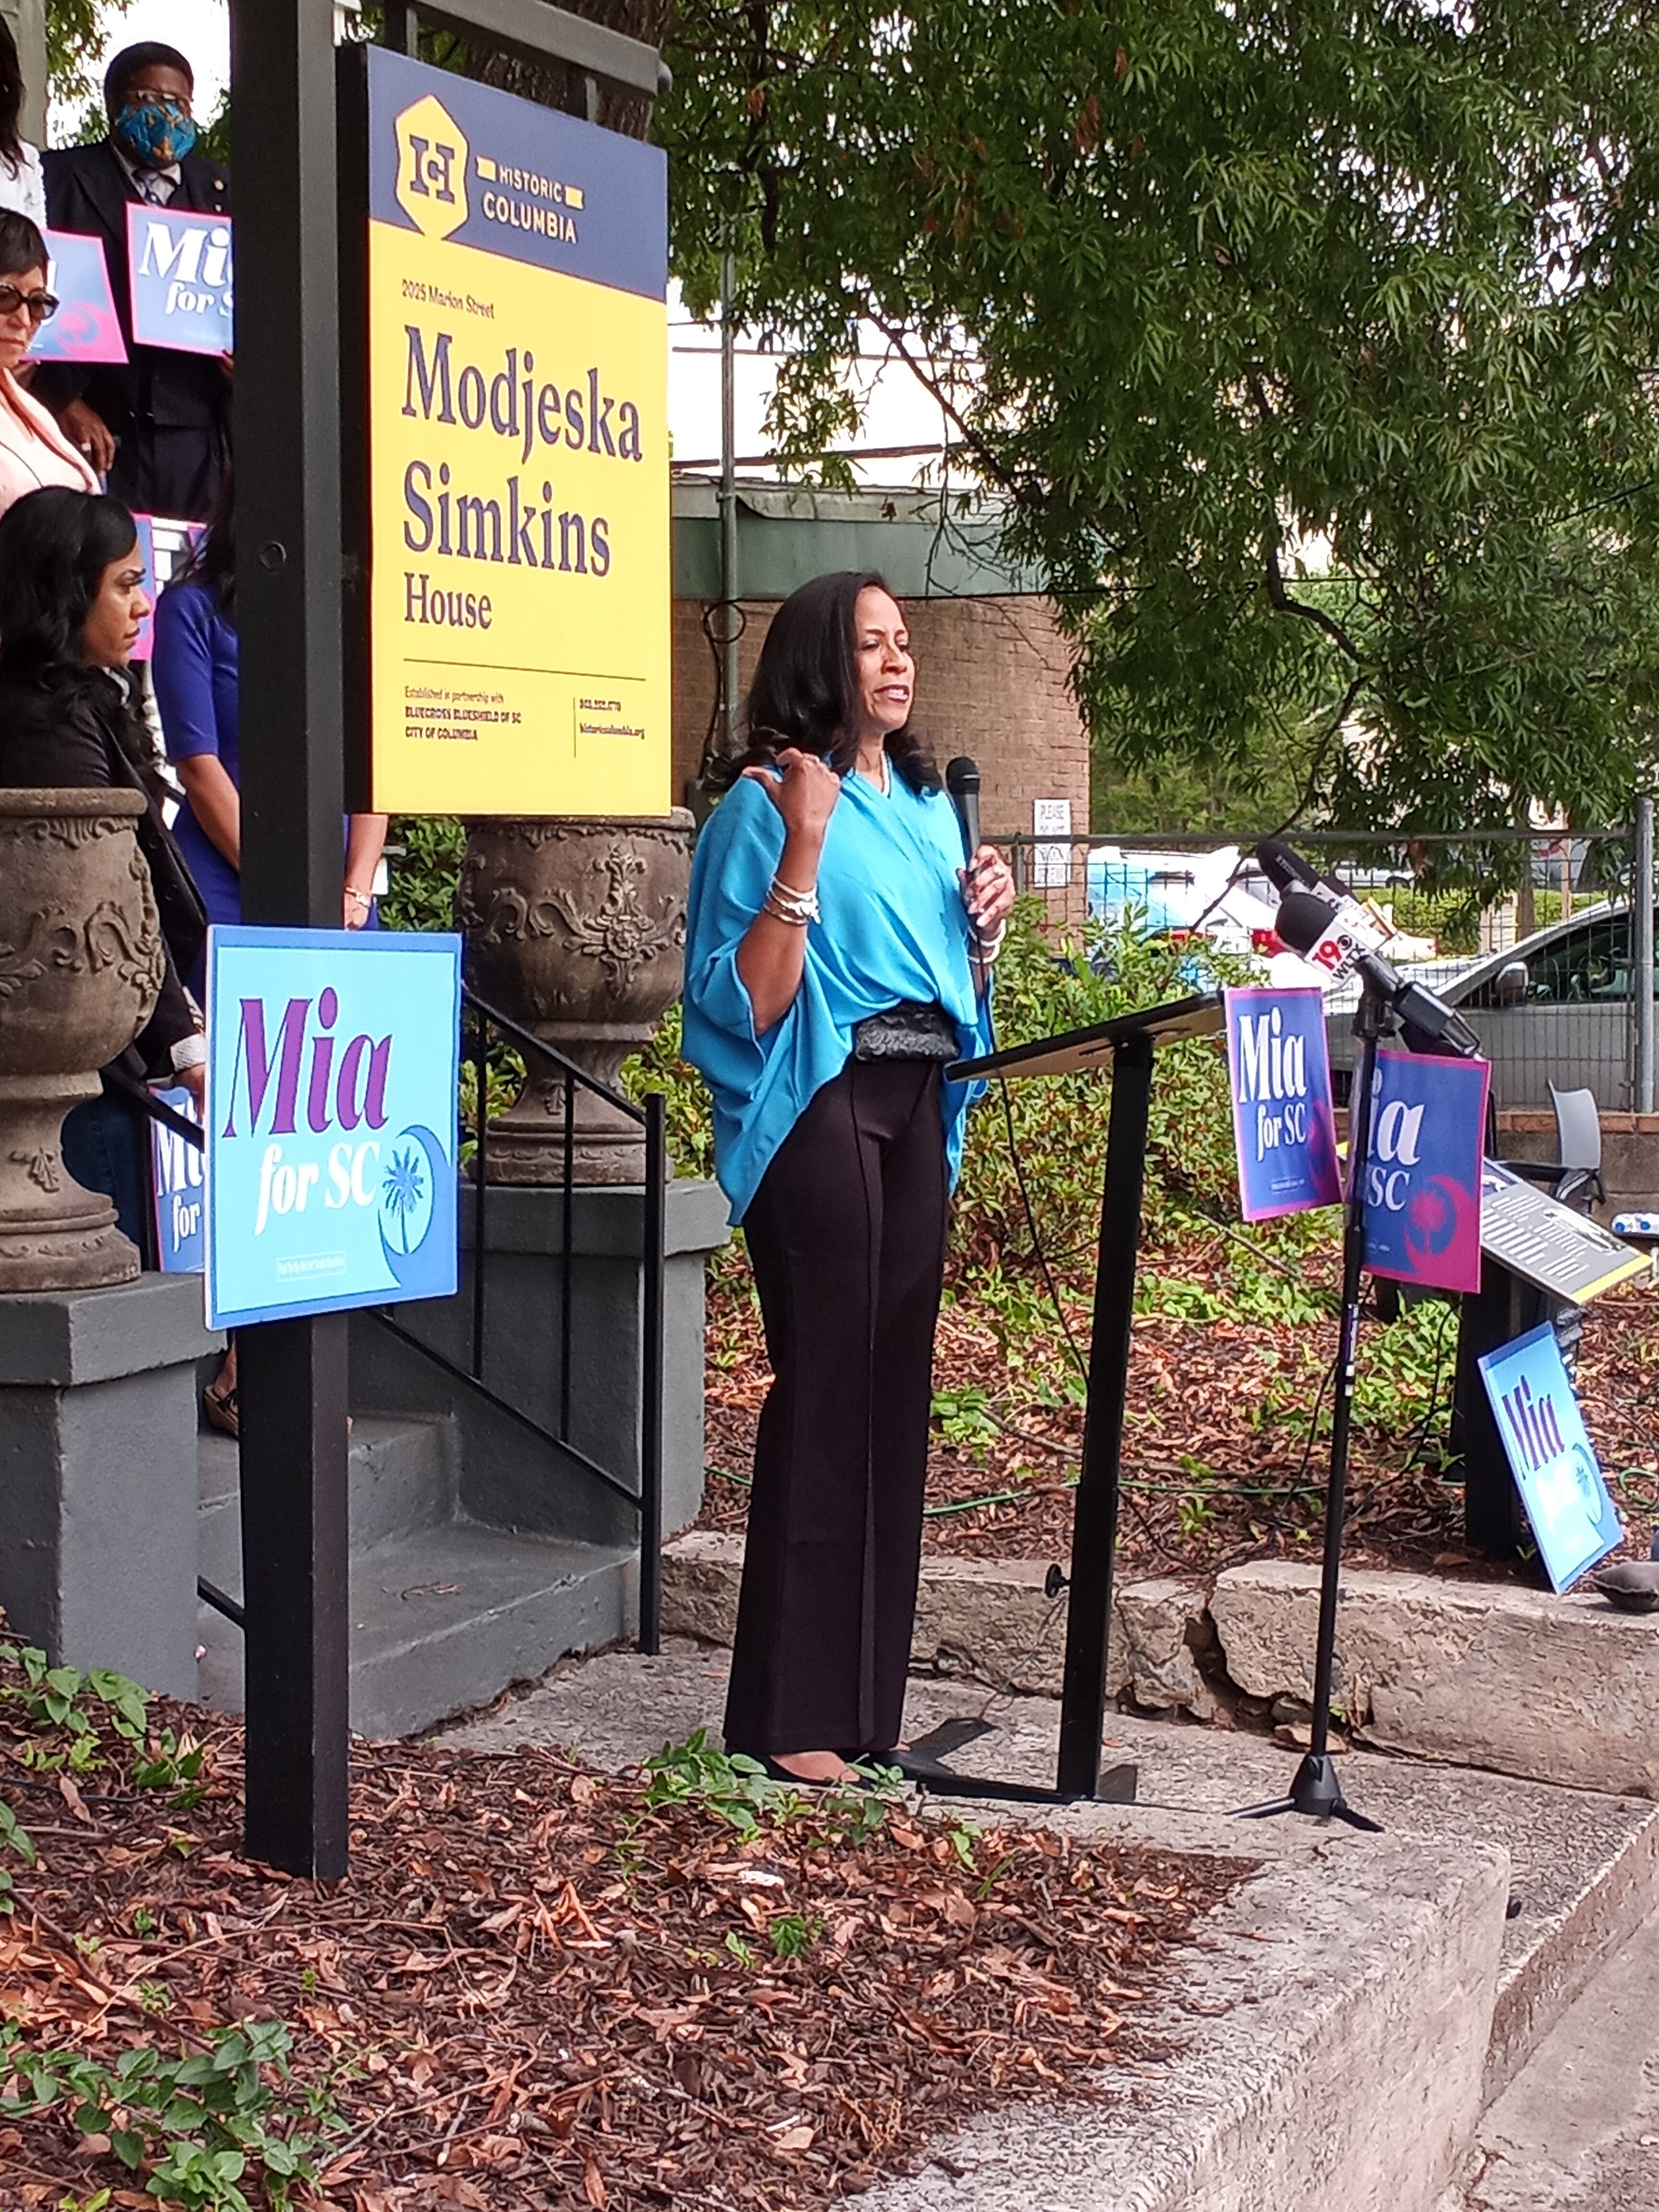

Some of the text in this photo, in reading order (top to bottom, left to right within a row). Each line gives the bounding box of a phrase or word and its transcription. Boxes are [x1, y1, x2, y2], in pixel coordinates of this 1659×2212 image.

[499, 165, 563, 204] HISTORIC
[482, 191, 578, 244] COLUMBIA
[137, 222, 233, 287] Mi
[165, 281, 215, 315] for
[402, 278, 495, 320] 2025 Marion Street
[402, 325, 643, 464] Modjeska
[404, 460, 610, 577] Simkins
[404, 572, 493, 629] House
[405, 726, 423, 739] CITY
[425, 727, 435, 739] OF
[1312, 940, 1342, 971] 19
[1333, 943, 1366, 980] WLTX
[221, 986, 392, 1138] Mia
[1238, 1006, 1307, 1103] Mia
[156, 1096, 205, 1197] Mi
[1256, 1101, 1307, 1162] for SC
[254, 1140, 381, 1237] for SC
[1368, 1168, 1410, 1211] SC
[172, 1194, 201, 1253] for
[1501, 1373, 1565, 1482] Mia
